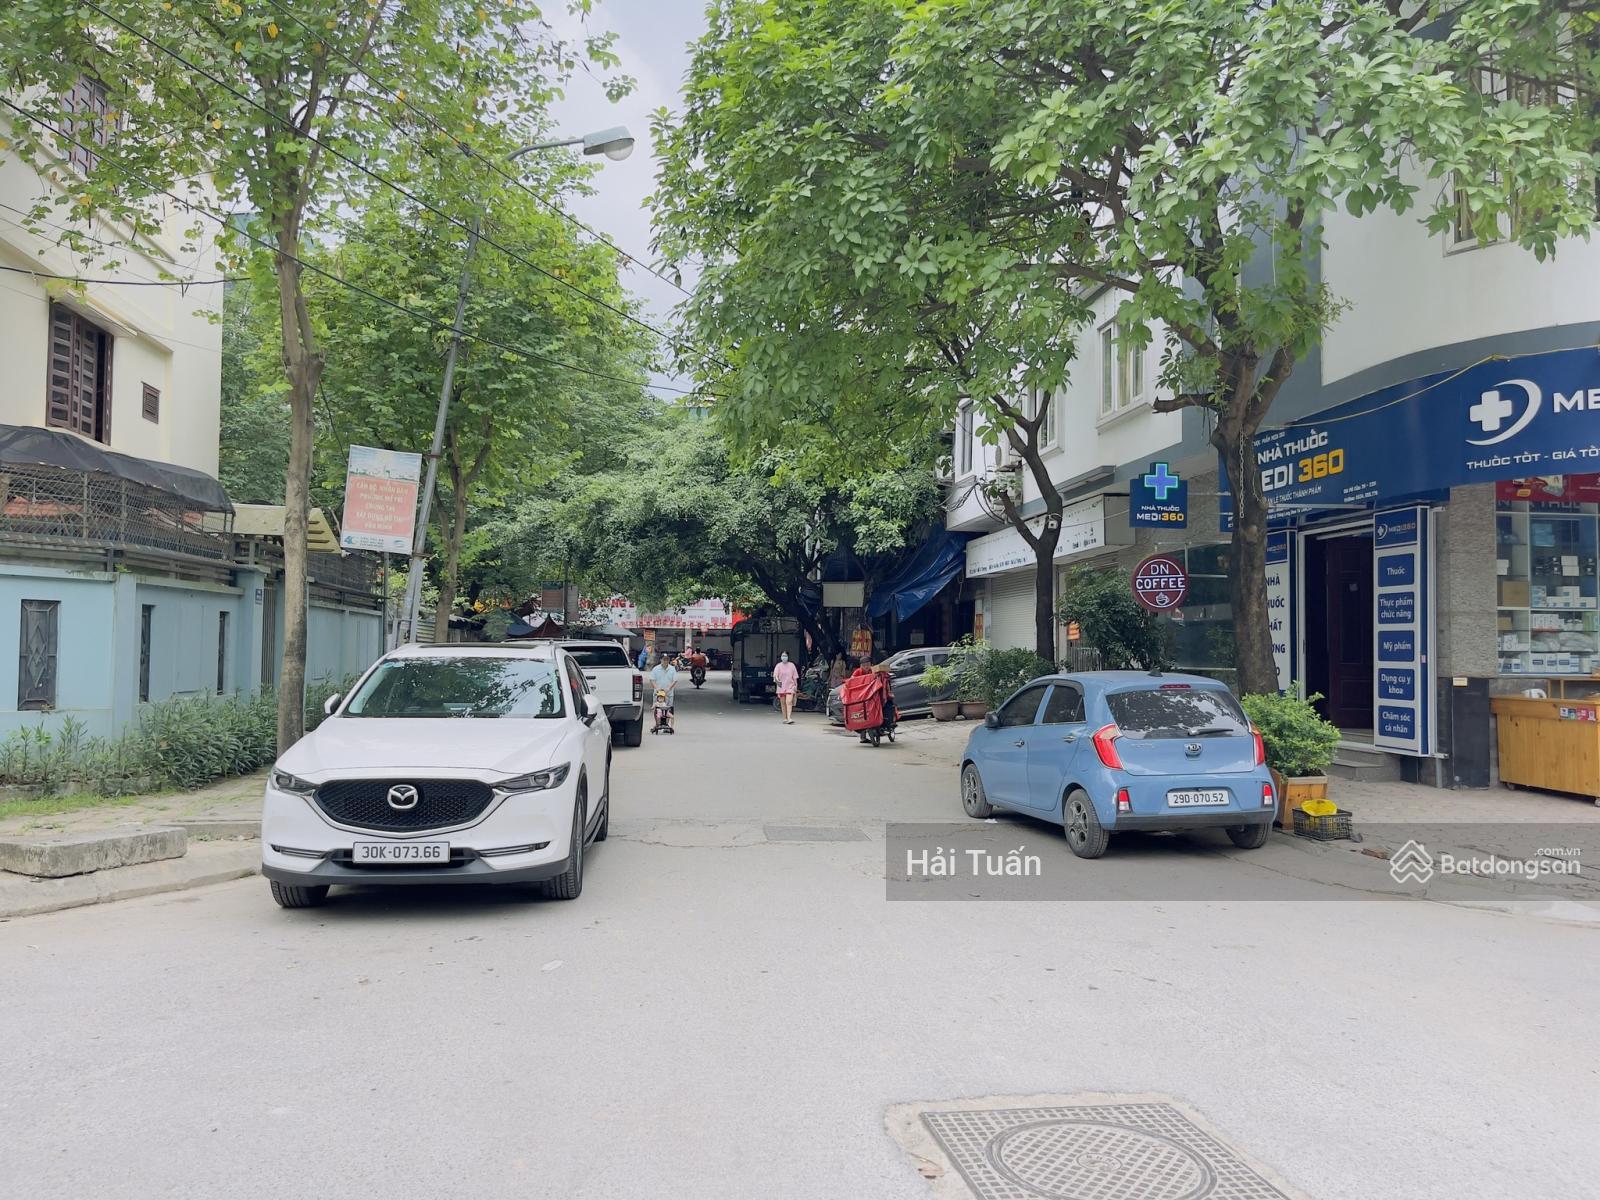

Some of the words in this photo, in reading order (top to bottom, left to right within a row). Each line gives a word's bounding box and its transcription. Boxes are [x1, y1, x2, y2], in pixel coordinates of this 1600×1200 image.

[1257, 443, 1282, 465] NHÀ
[1552, 446, 1576, 460] GIÁ
[1262, 463, 1293, 493] EDI
[1297, 448, 1345, 483] 360
[1136, 512, 1184, 522] MEDI360
[1150, 564, 1169, 575] DN
[1136, 578, 1186, 590] COFFEE
[1388, 684, 1404, 695] khoa
[362, 846, 441, 859] 30K-073.66
